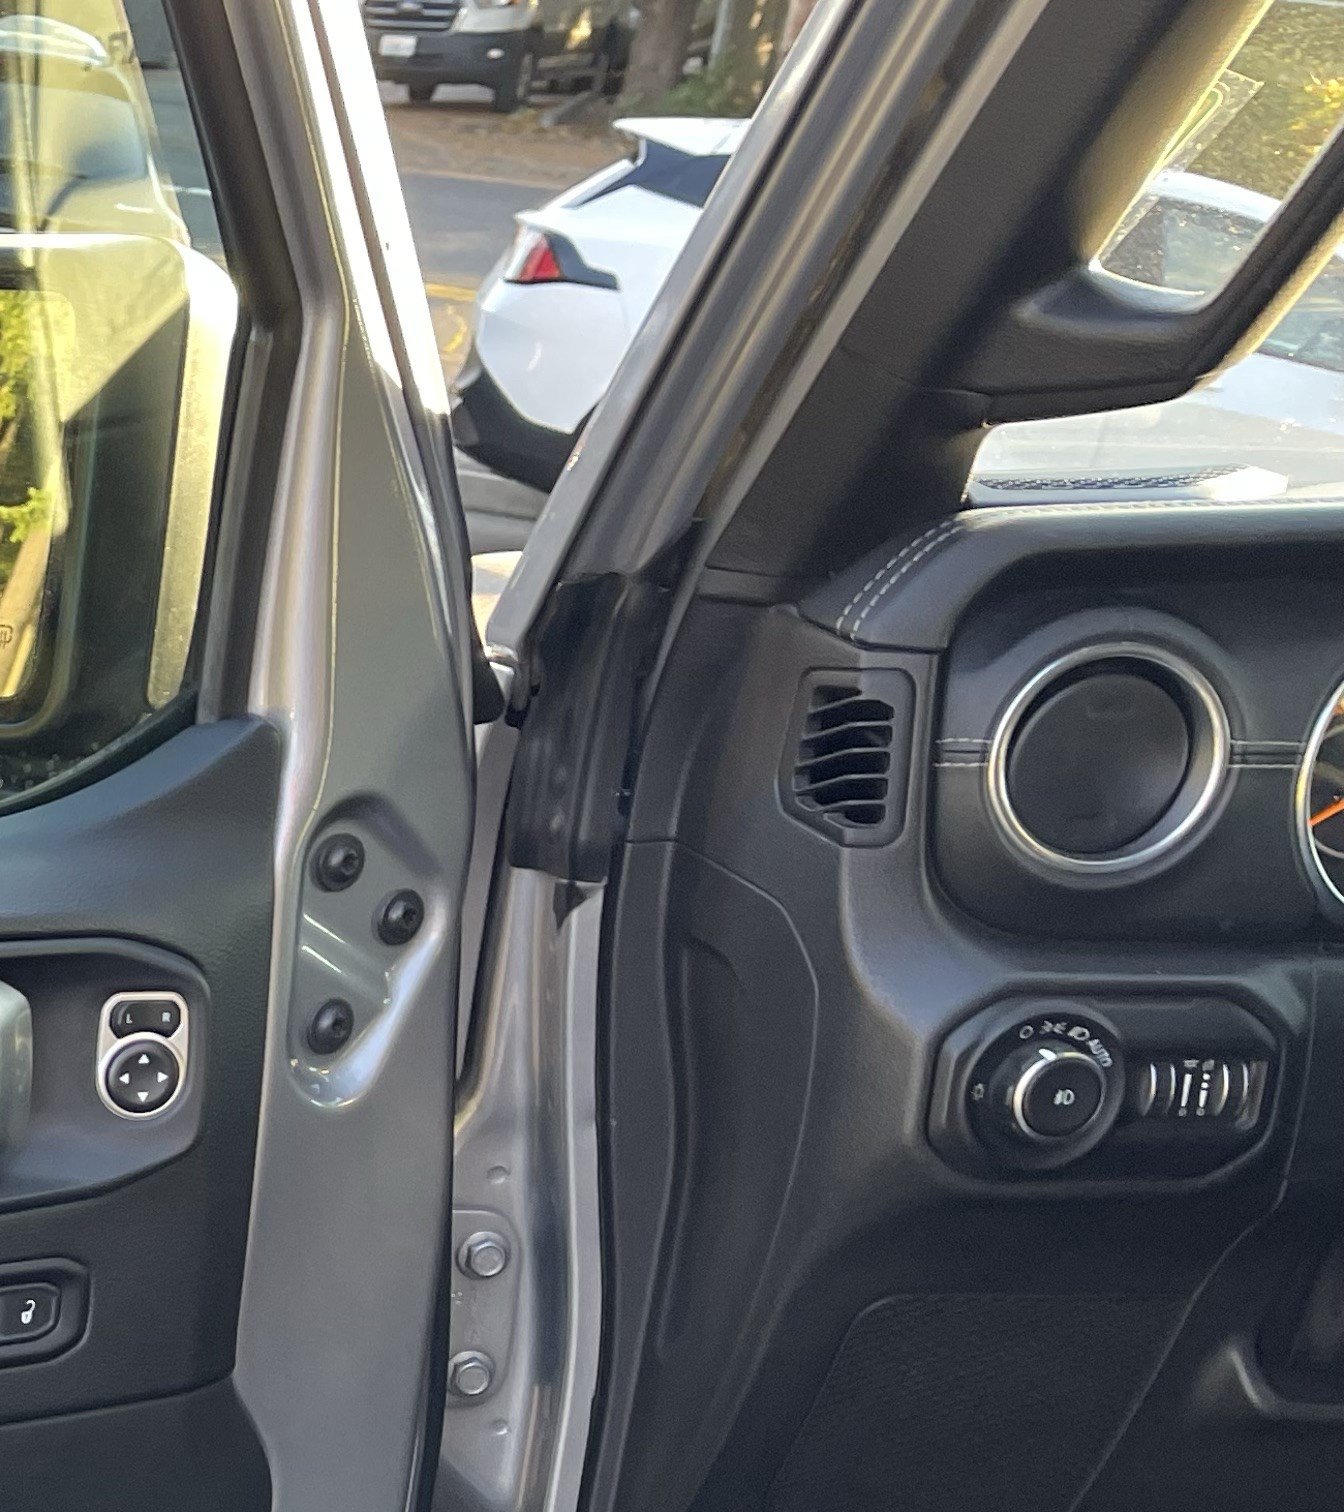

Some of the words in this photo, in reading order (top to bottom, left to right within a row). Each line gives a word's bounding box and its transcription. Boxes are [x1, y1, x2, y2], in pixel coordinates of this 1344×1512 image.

[125, 1013, 133, 1024] L
[161, 1011, 171, 1023] R
[1087, 1038, 1113, 1068] AUTO
